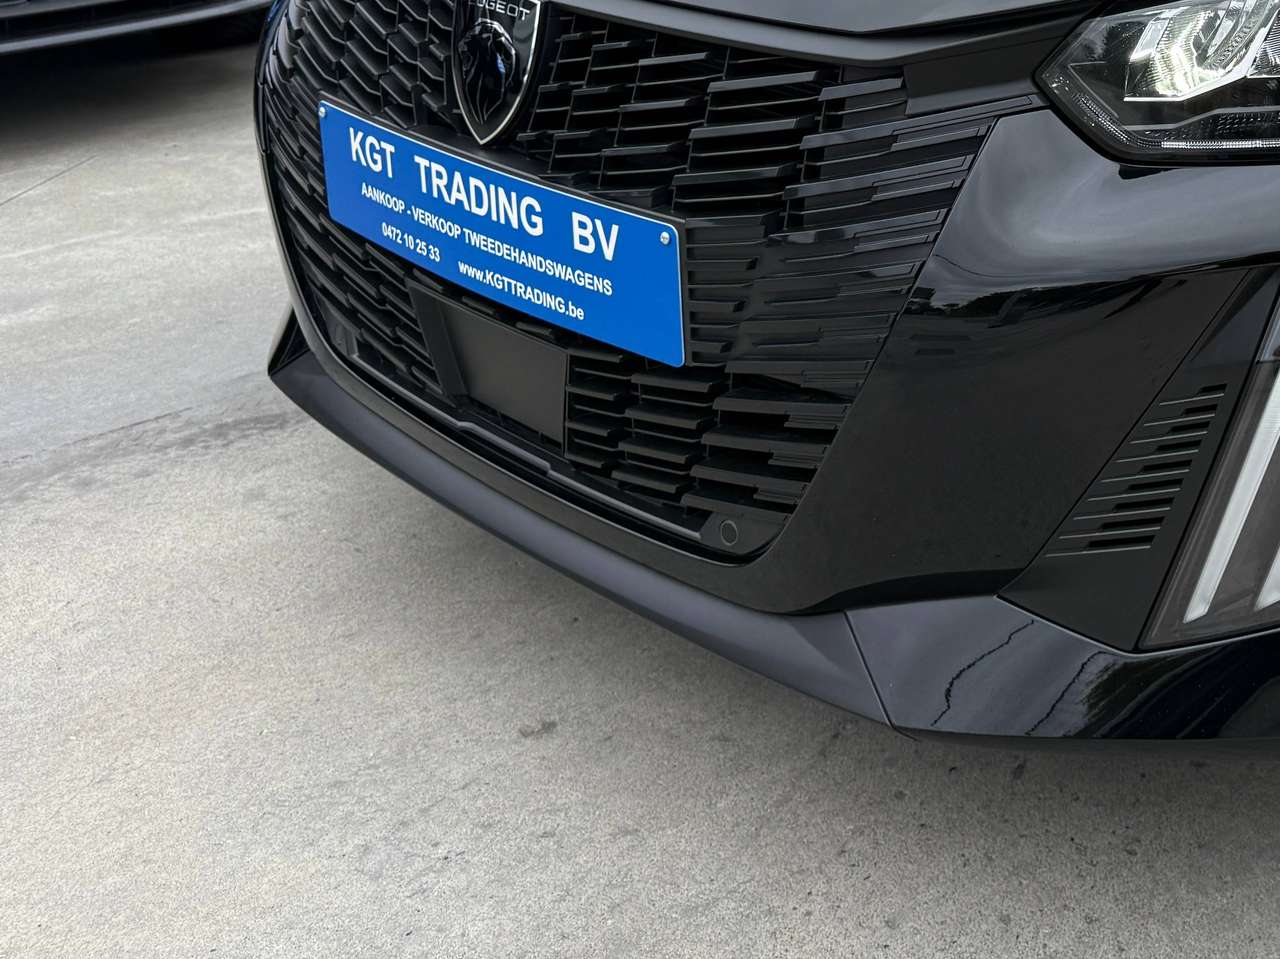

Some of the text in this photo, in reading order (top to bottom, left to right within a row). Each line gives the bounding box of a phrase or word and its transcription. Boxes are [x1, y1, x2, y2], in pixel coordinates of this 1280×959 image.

[349, 127, 619, 261] KGT TRADING BV
[361, 182, 406, 214] AANKOOP
[411, 205, 462, 239] VERKOOP
[463, 227, 613, 296] TWEEDEHANDSWAGENS
[382, 222, 441, 262] 0472 10 25 33
[458, 261, 585, 321] www.KGTTRADING.be
